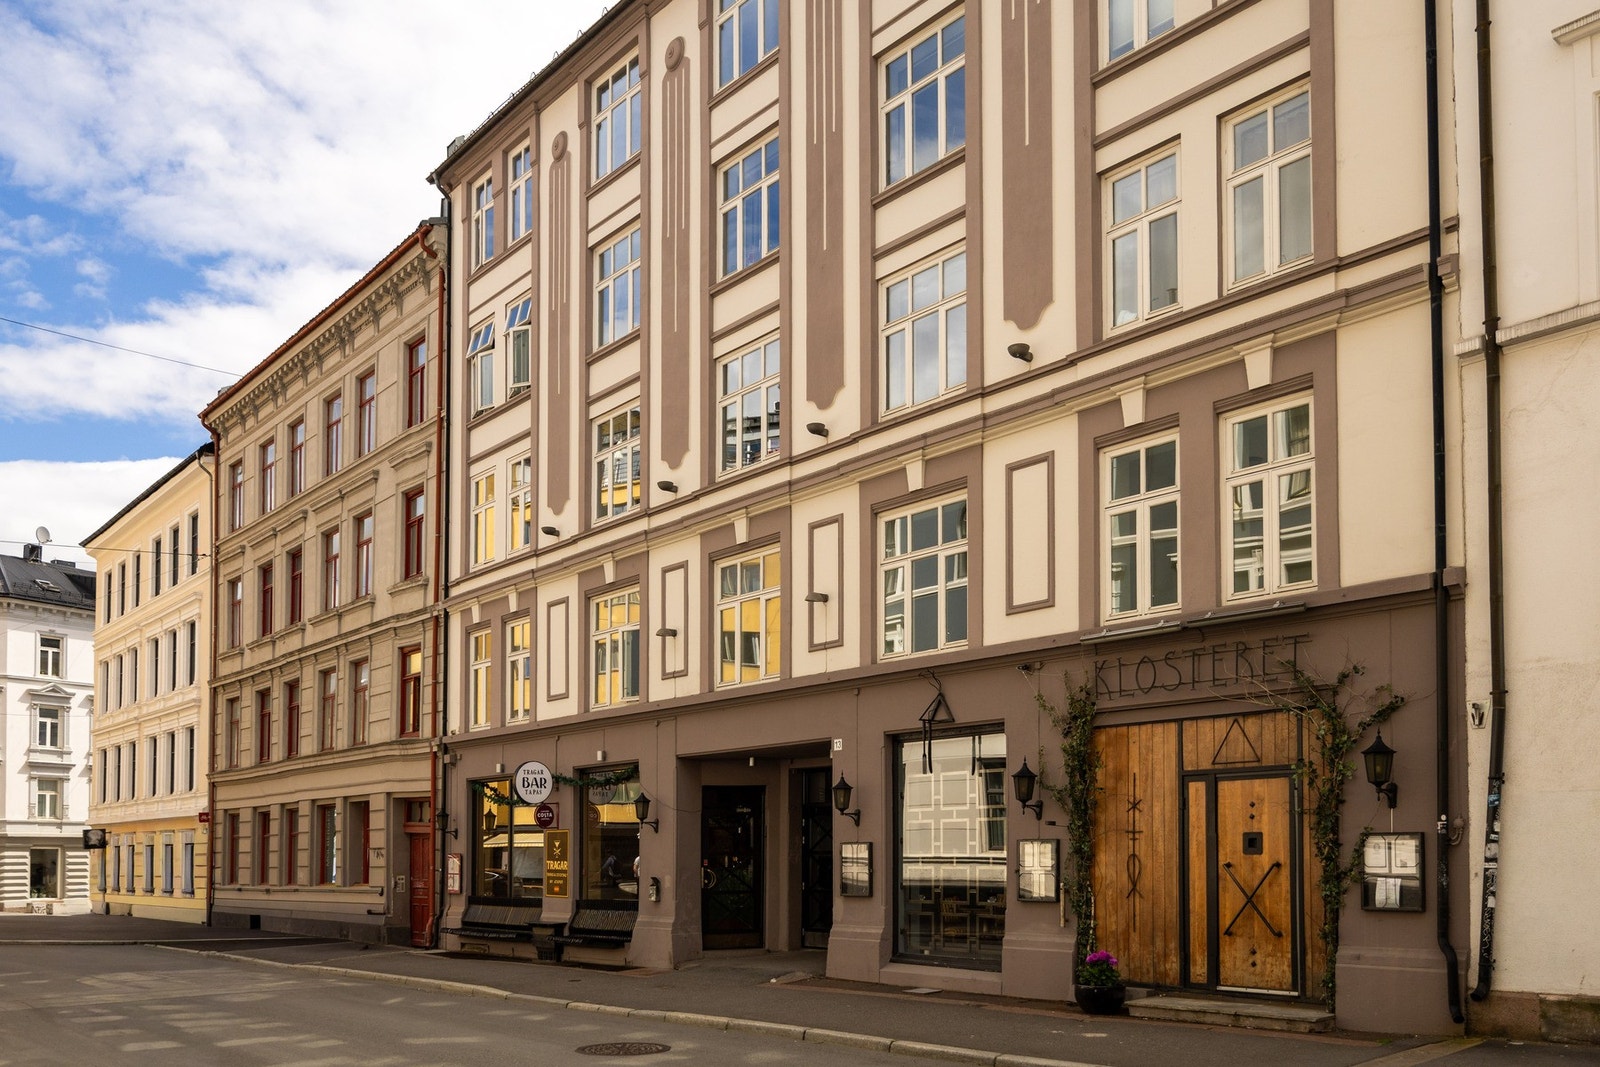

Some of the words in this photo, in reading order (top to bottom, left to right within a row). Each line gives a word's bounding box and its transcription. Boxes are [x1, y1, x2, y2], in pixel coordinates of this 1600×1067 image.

[1093, 632, 1310, 701] KLOSTERET
[835, 740, 842, 750] 13
[522, 776, 547, 789] BAR
[546, 860, 568, 870] TRAGAR
